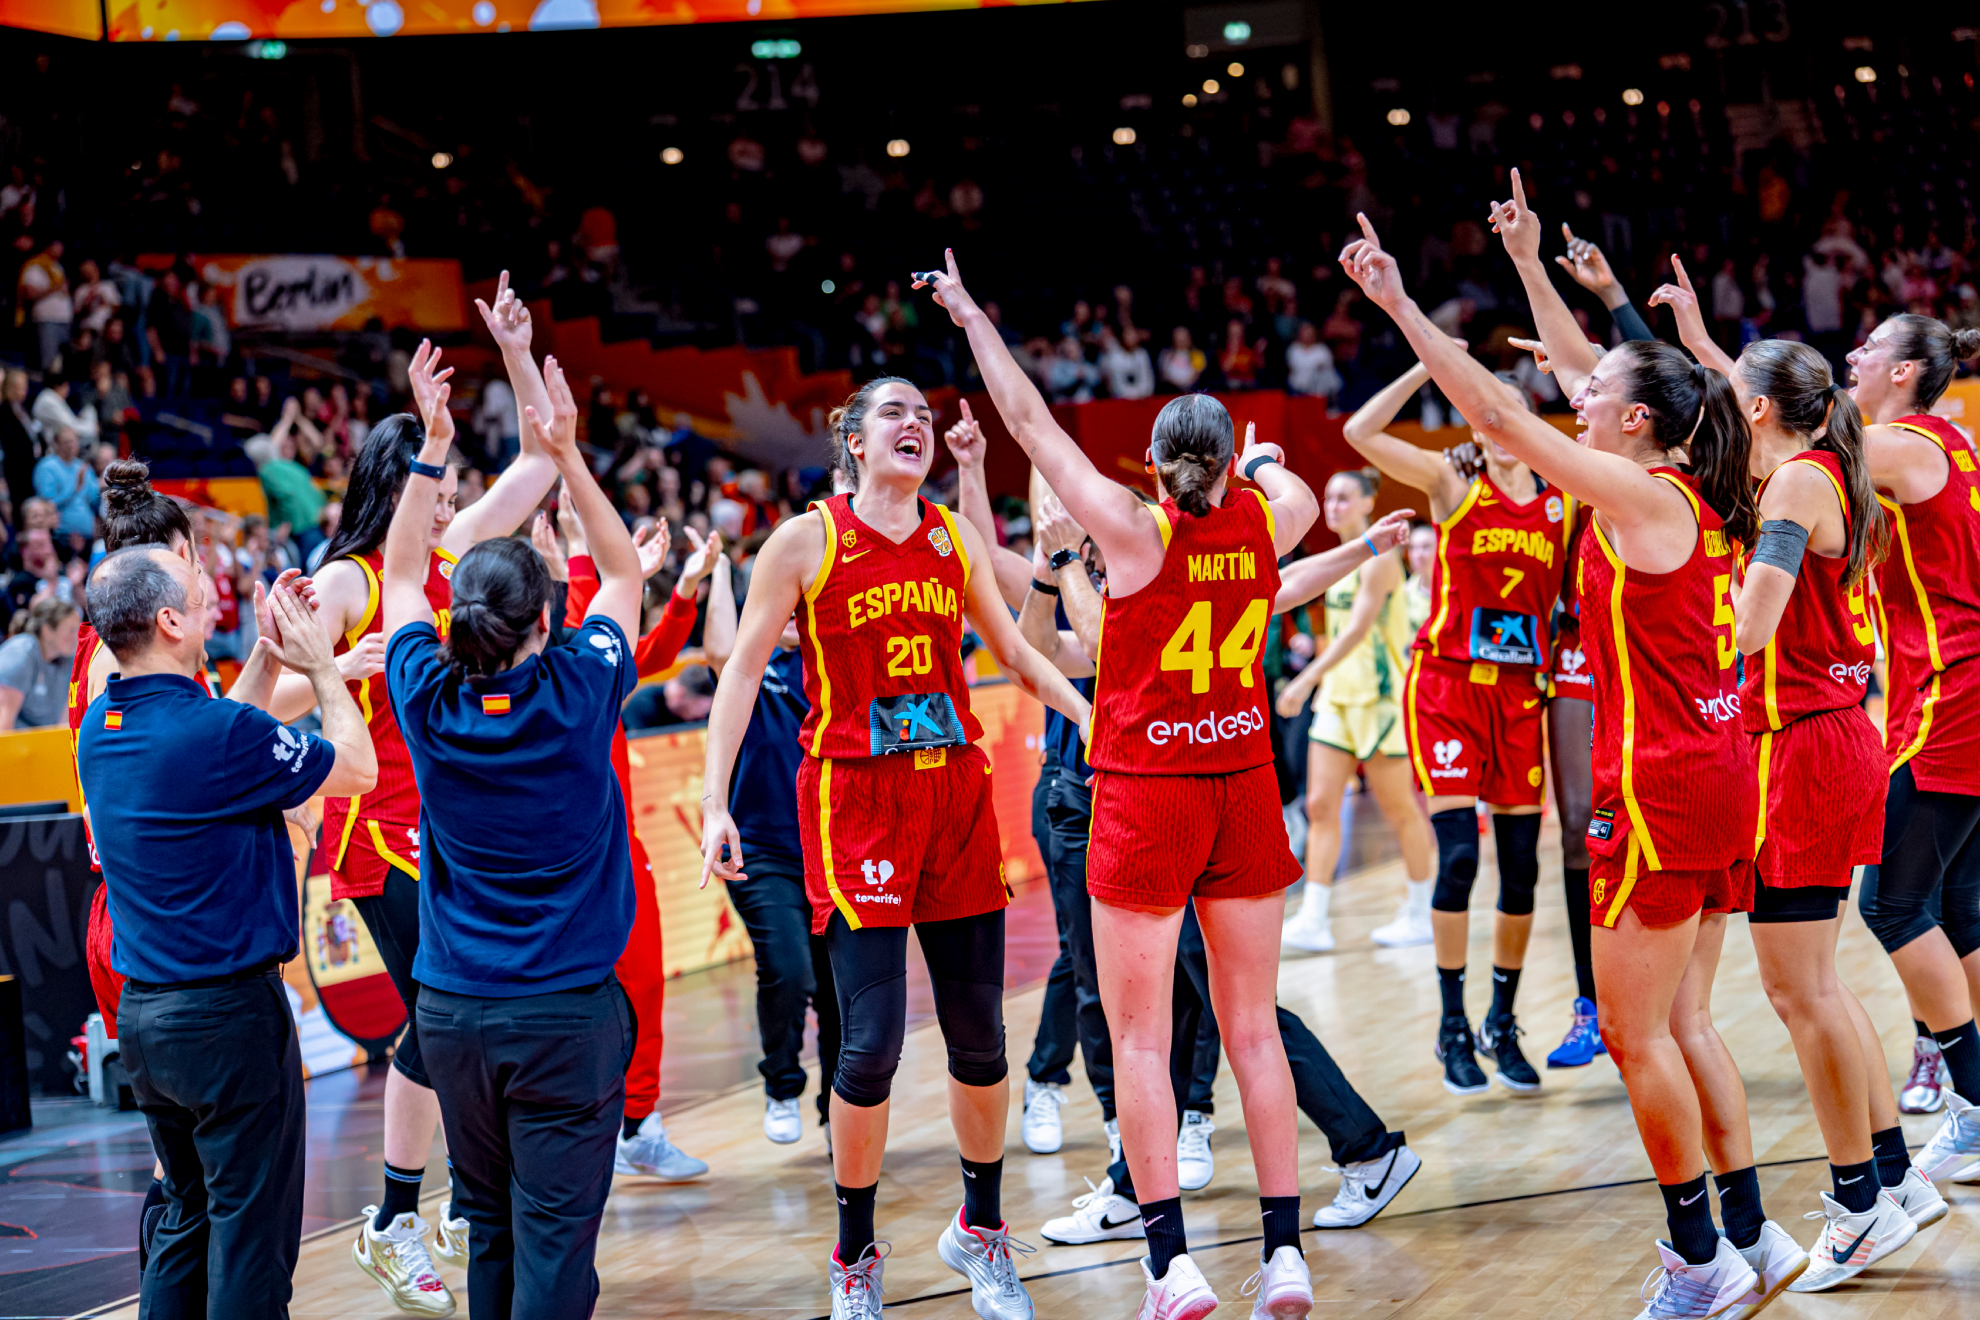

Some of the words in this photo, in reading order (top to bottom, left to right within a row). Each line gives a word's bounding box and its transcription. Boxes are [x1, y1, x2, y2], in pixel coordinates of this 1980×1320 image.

[735, 62, 820, 111] 214
[245, 267, 354, 317] Berlin
[1188, 546, 1256, 582] MARTÍN
[1472, 527, 1554, 569] ESPAÑA
[847, 577, 958, 629] ESPAÑA
[1500, 567, 1525, 599] 7
[1713, 574, 1737, 670] 5
[1848, 573, 1875, 647] 9
[886, 635, 933, 677] 20
[1160, 599, 1269, 694] 44
[1147, 705, 1264, 745] endesa
